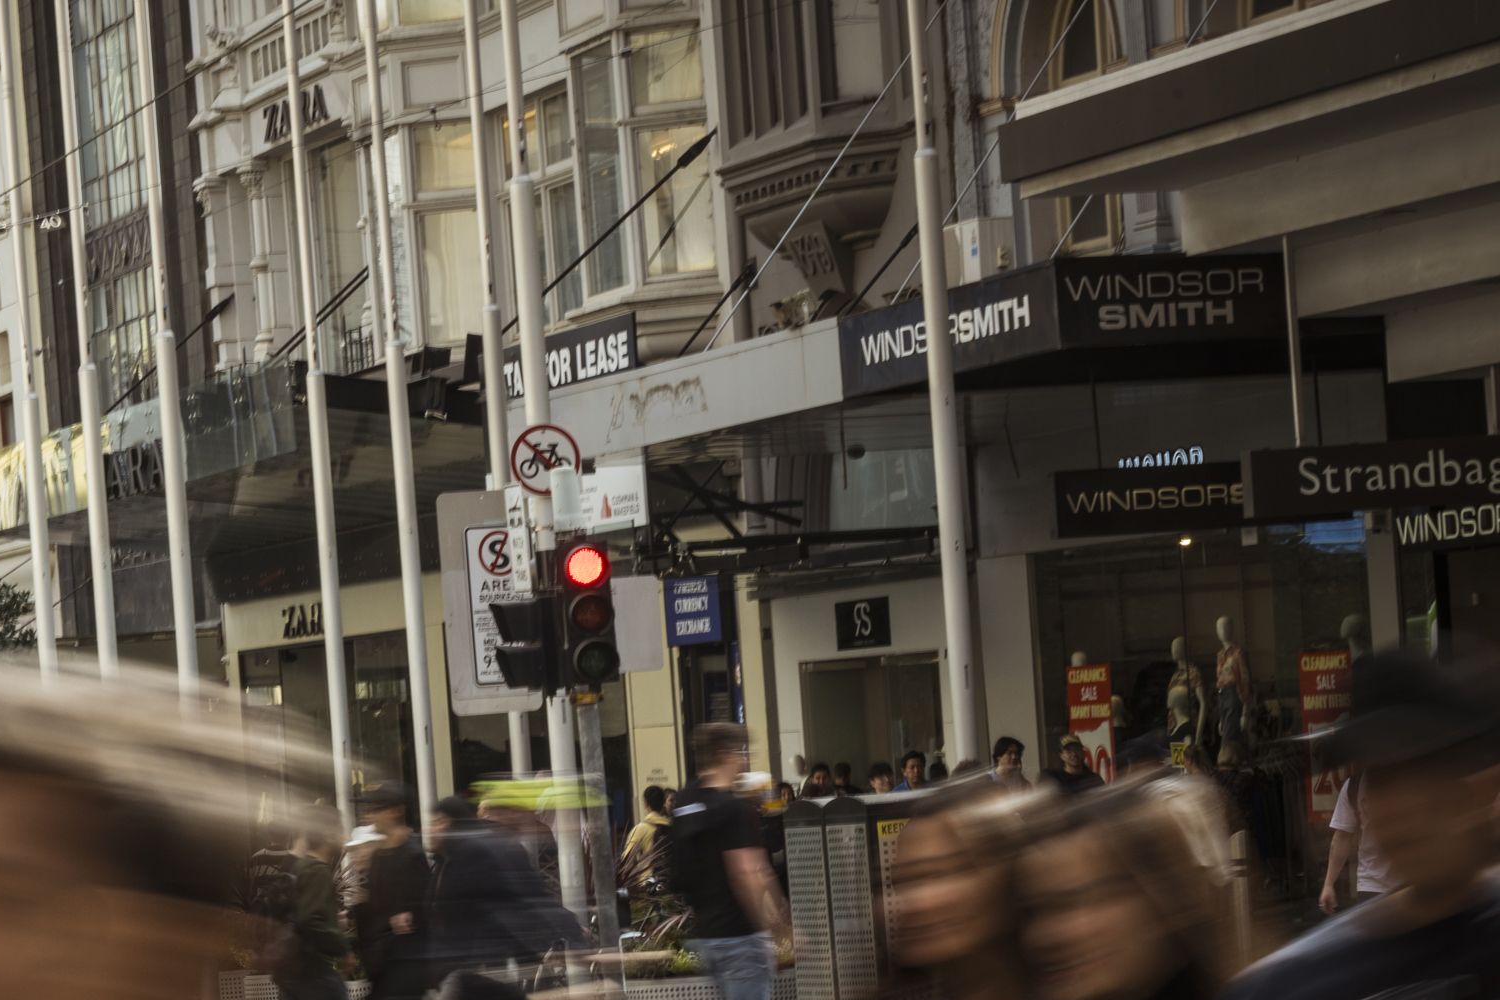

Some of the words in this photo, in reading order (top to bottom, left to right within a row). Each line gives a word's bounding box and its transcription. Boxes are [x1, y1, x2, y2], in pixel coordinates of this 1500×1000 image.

[40, 215, 62, 230] 40
[1064, 268, 1264, 302] WINDSOR
[1098, 300, 1235, 331] SMITH
[860, 294, 1030, 366] WINDSRSMITH
[546, 348, 572, 387] OR
[576, 329, 630, 381] LEASE
[104, 440, 167, 499] ARA
[481, 579, 514, 593] ARE
[674, 594, 709, 614] CURRENCY
[282, 602, 325, 639] ZAR
[676, 616, 711, 636] EXCHANGE
[1301, 653, 1347, 672] CLEARANCE
[1068, 666, 1107, 684] CLEARANCE
[1316, 674, 1336, 691] SALE
[1080, 685, 1098, 702] SALE
[1303, 694, 1328, 711] MANY
[1328, 692, 1351, 709] ITEMS
[1091, 702, 1111, 719] ITEMS
